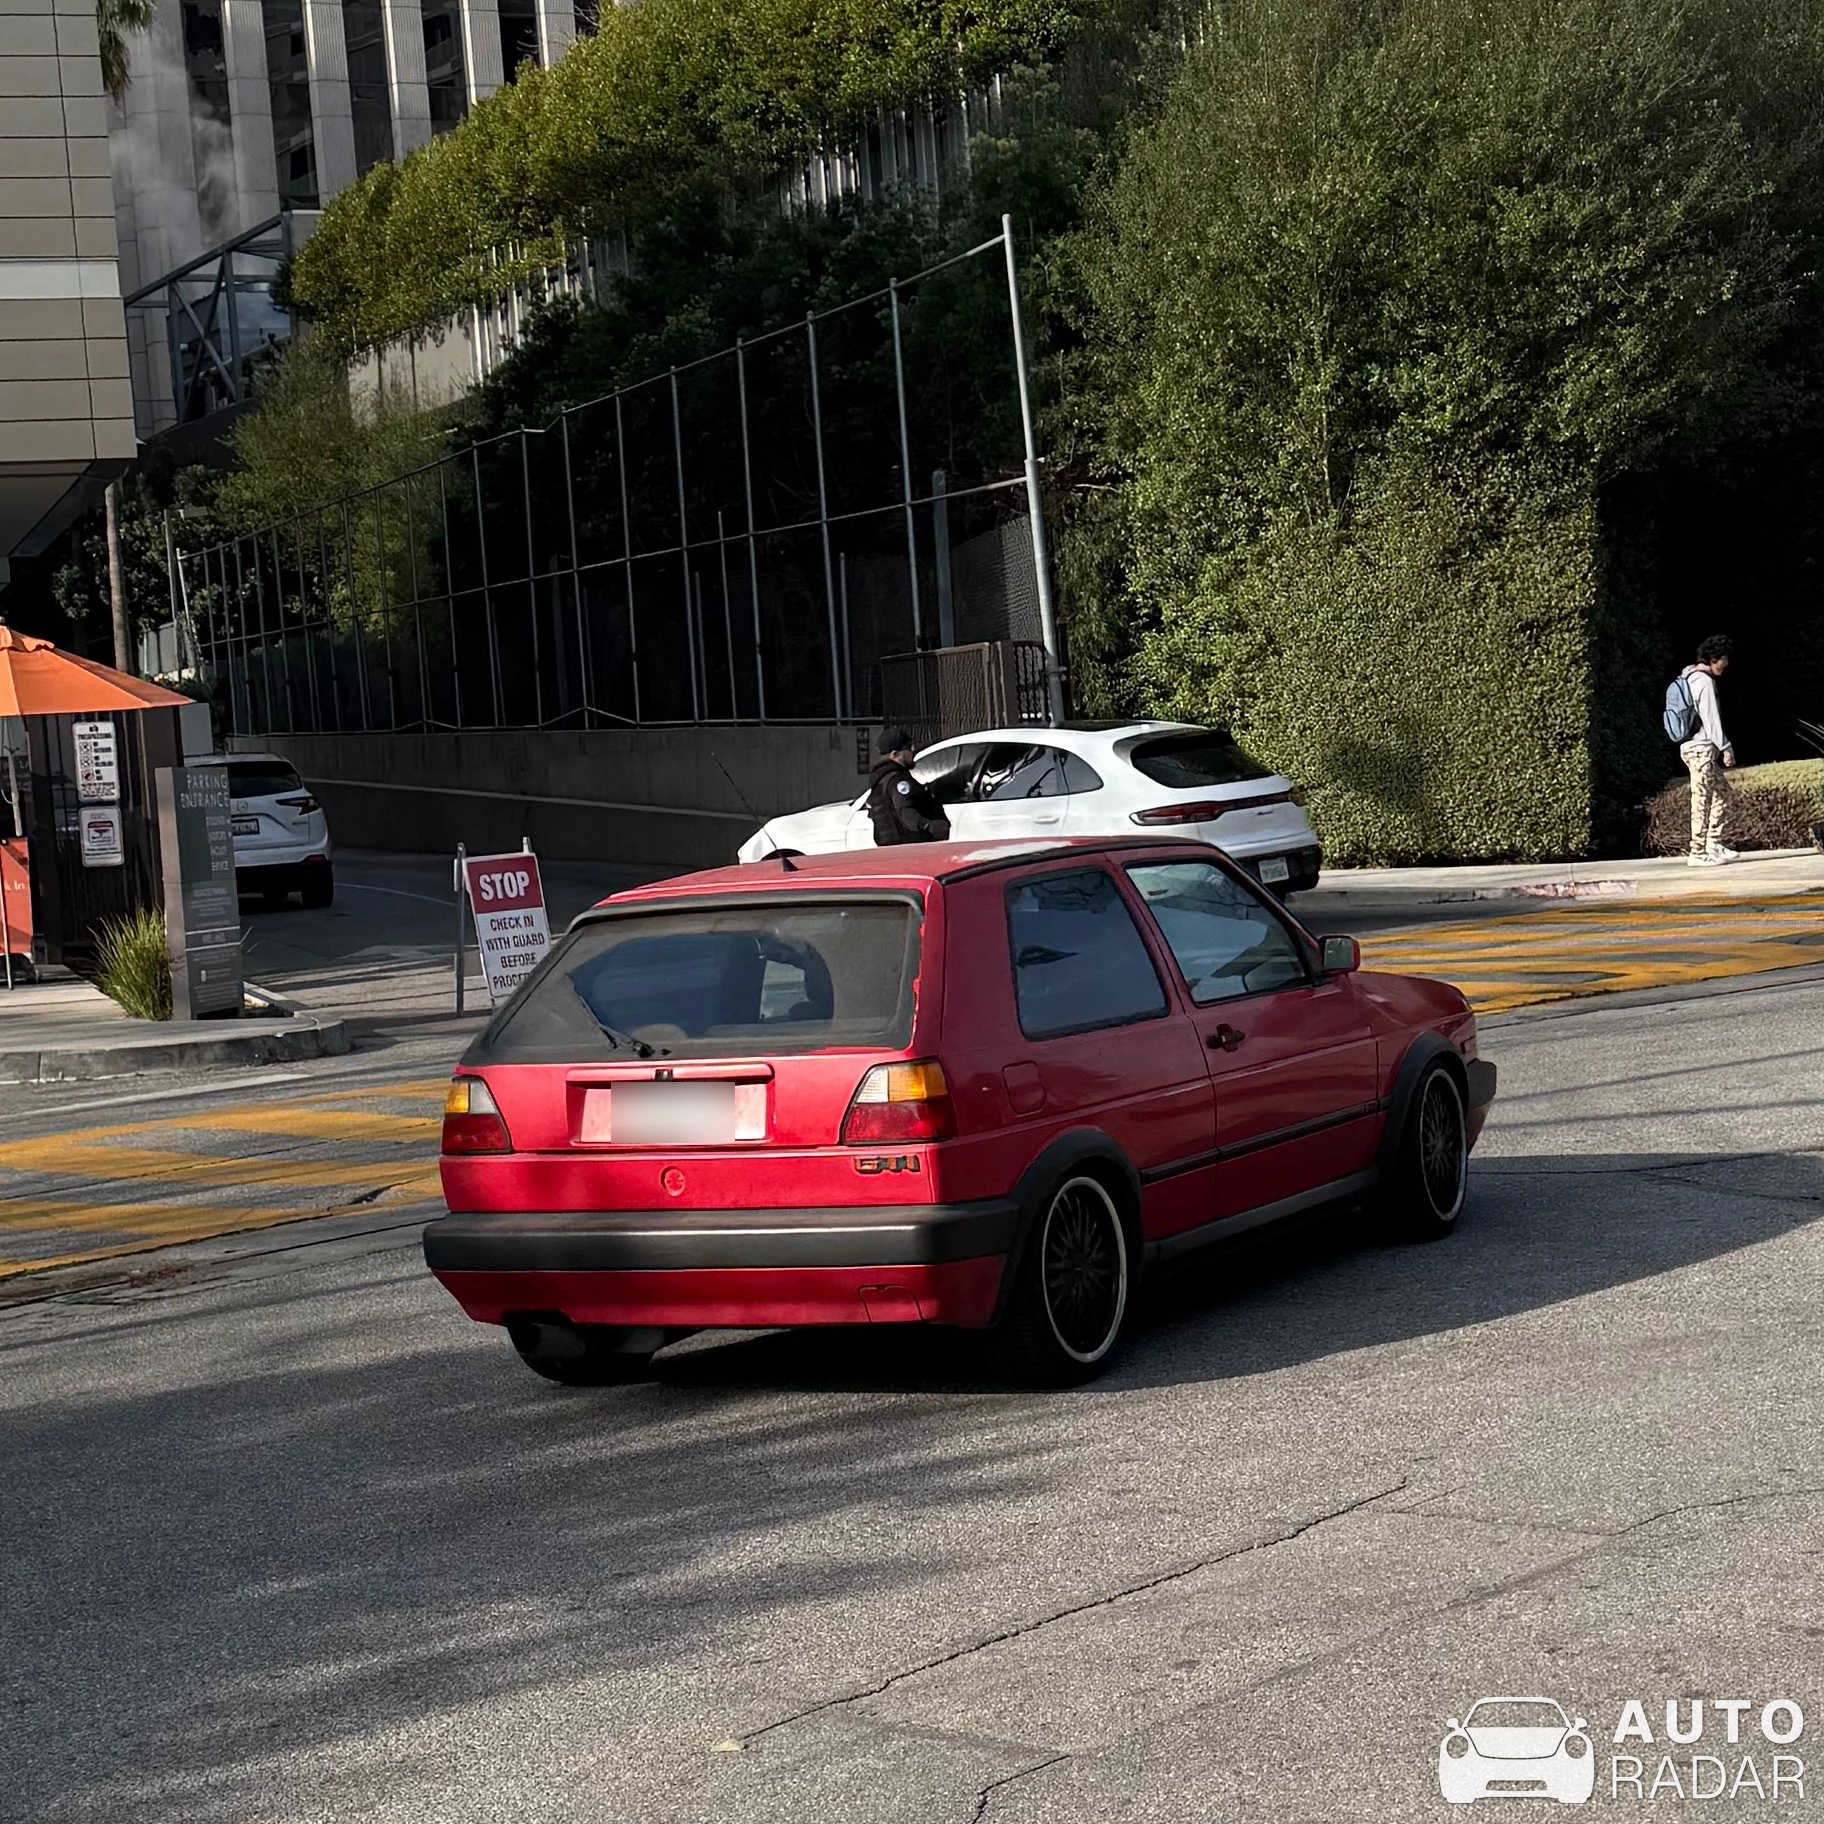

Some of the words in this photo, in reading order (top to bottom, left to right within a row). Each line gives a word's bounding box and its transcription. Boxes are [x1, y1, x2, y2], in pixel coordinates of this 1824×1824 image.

[187, 774, 228, 789] PARKING
[180, 792, 230, 808] ENTRANCE
[479, 871, 530, 901] STOP
[490, 916, 522, 931] CHECK
[523, 915, 534, 928] IN
[486, 936, 510, 952] WITH
[512, 933, 545, 948] GUARD
[500, 952, 537, 969] BEFORE
